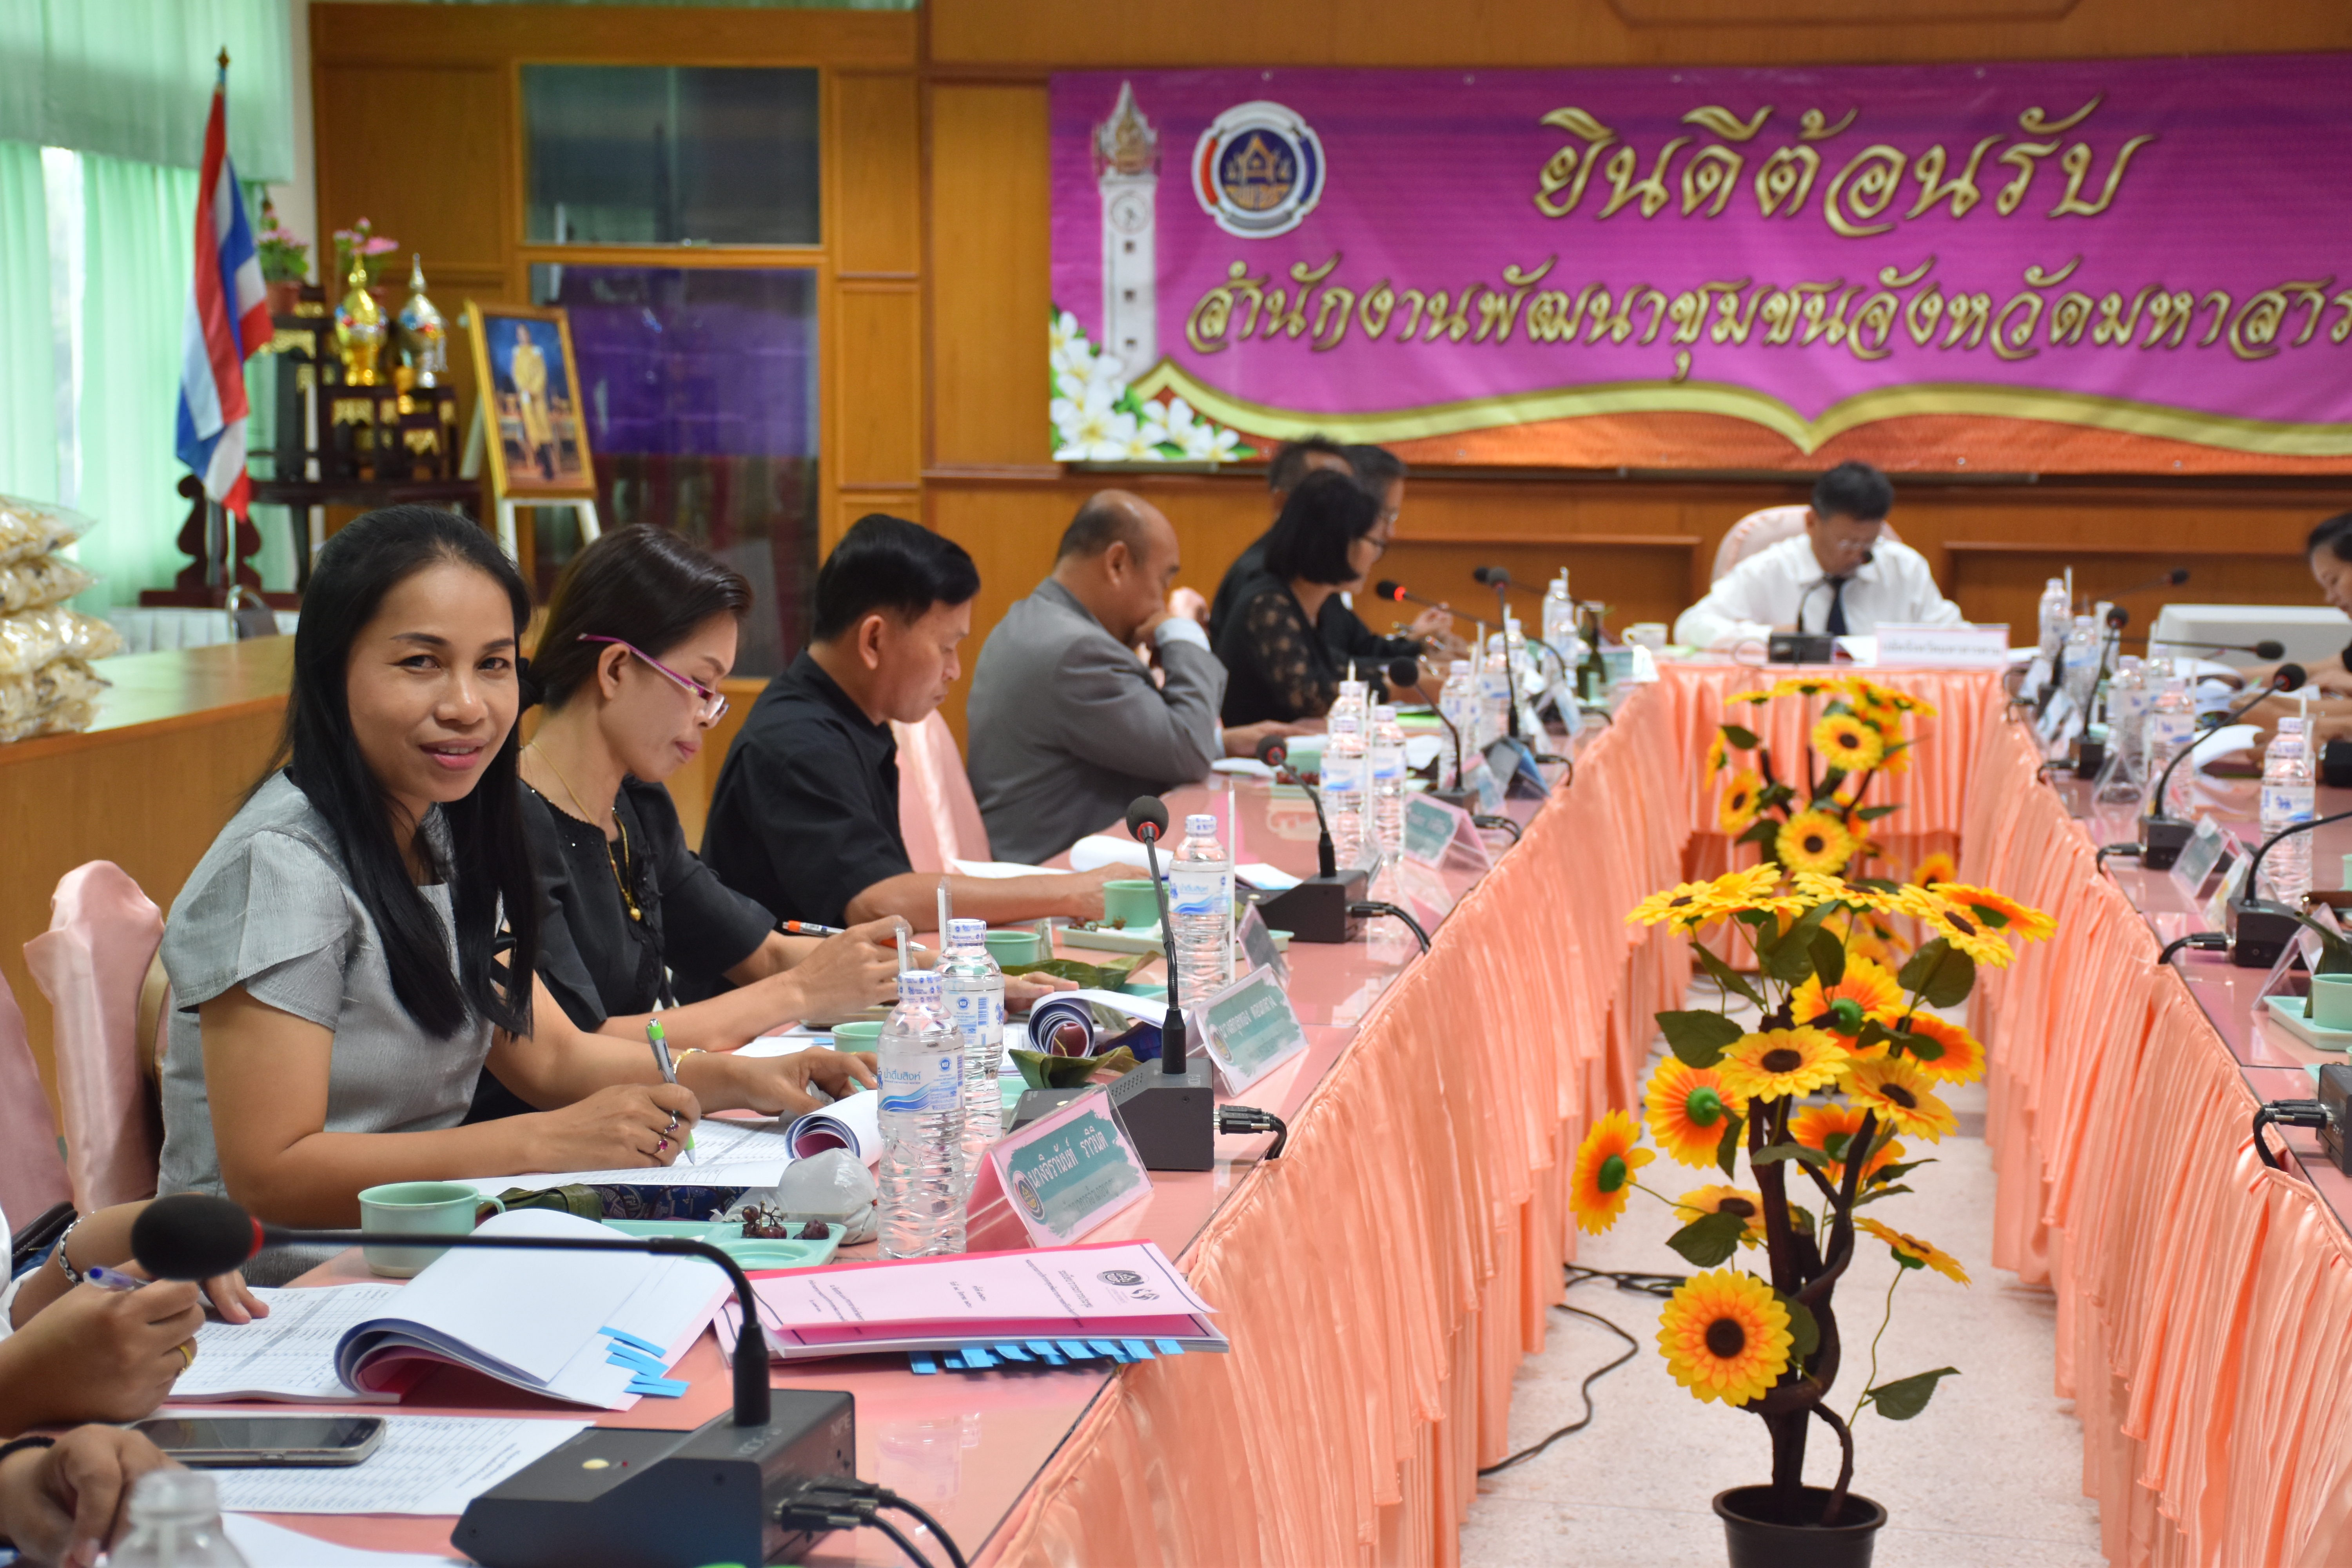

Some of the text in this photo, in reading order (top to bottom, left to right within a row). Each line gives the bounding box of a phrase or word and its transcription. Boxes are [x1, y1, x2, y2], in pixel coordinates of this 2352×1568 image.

[1534, 92, 2158, 237] ยินดีต้อนรับ
[884, 1068, 921, 1081] น้ำดื่มสิงห์
